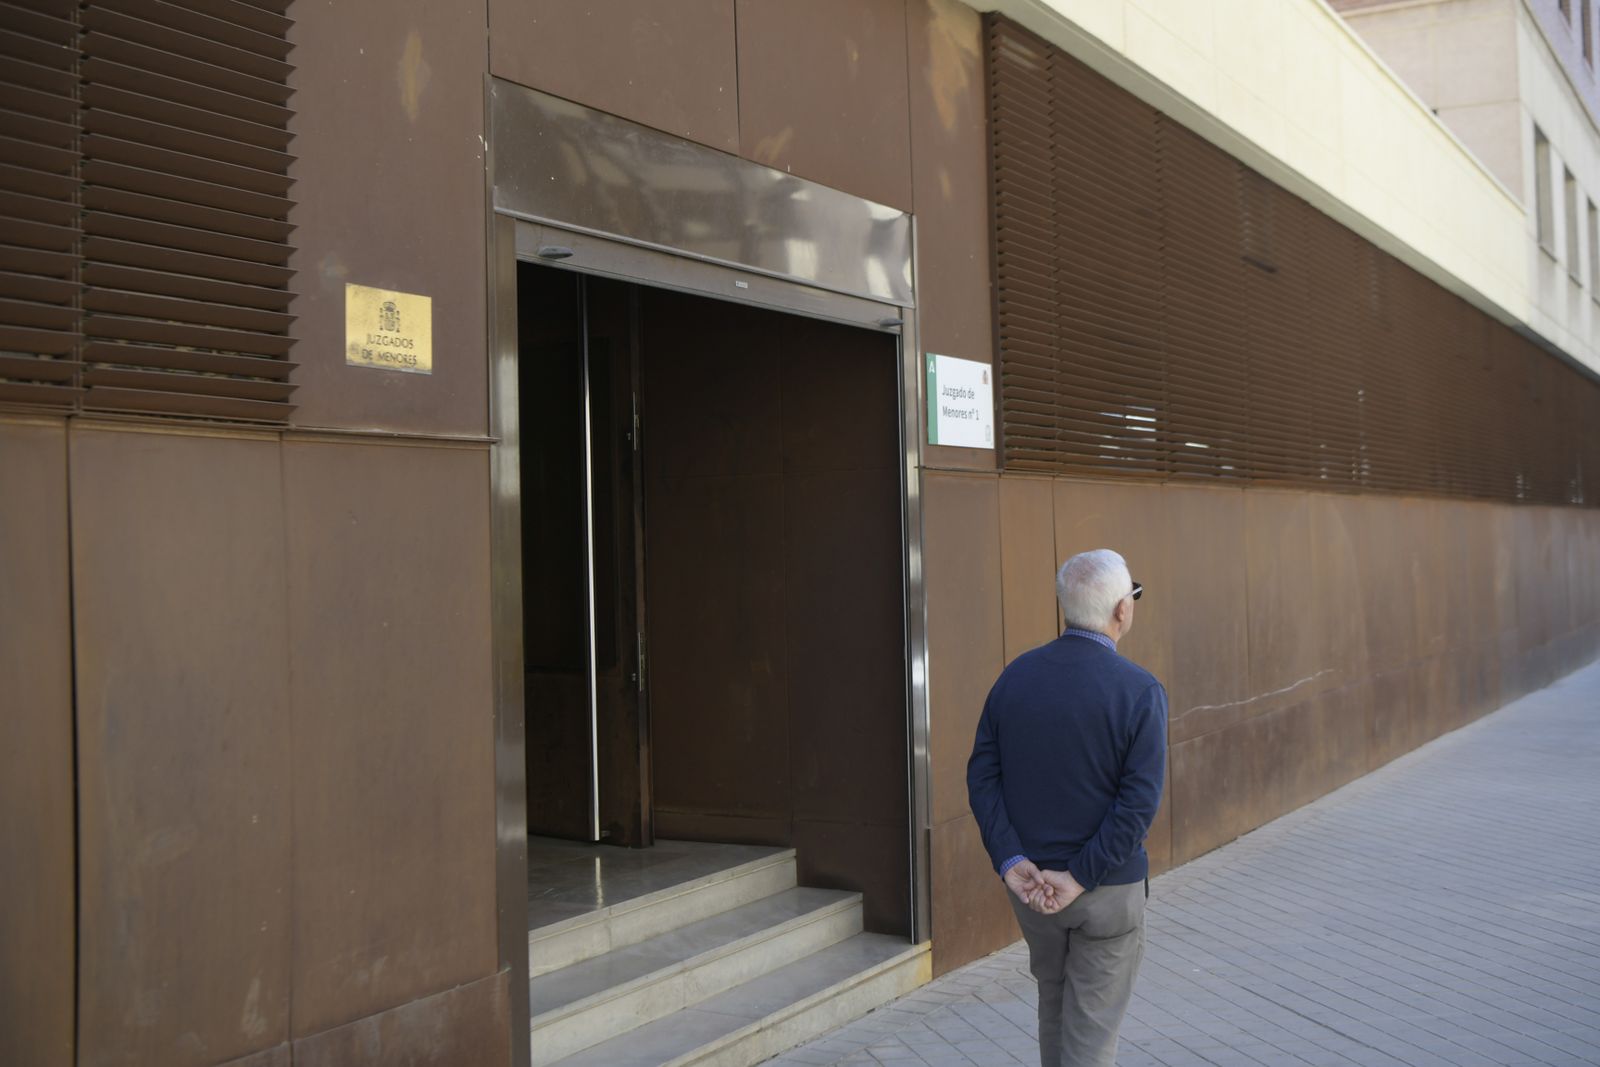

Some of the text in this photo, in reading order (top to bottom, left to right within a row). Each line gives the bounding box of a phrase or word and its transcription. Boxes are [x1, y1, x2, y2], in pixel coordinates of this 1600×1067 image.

[366, 333, 414, 350] JUZGADOS
[361, 348, 417, 365] DE MENORES
[942, 384, 975, 400] Juzgado de
[942, 405, 968, 419] Menores
